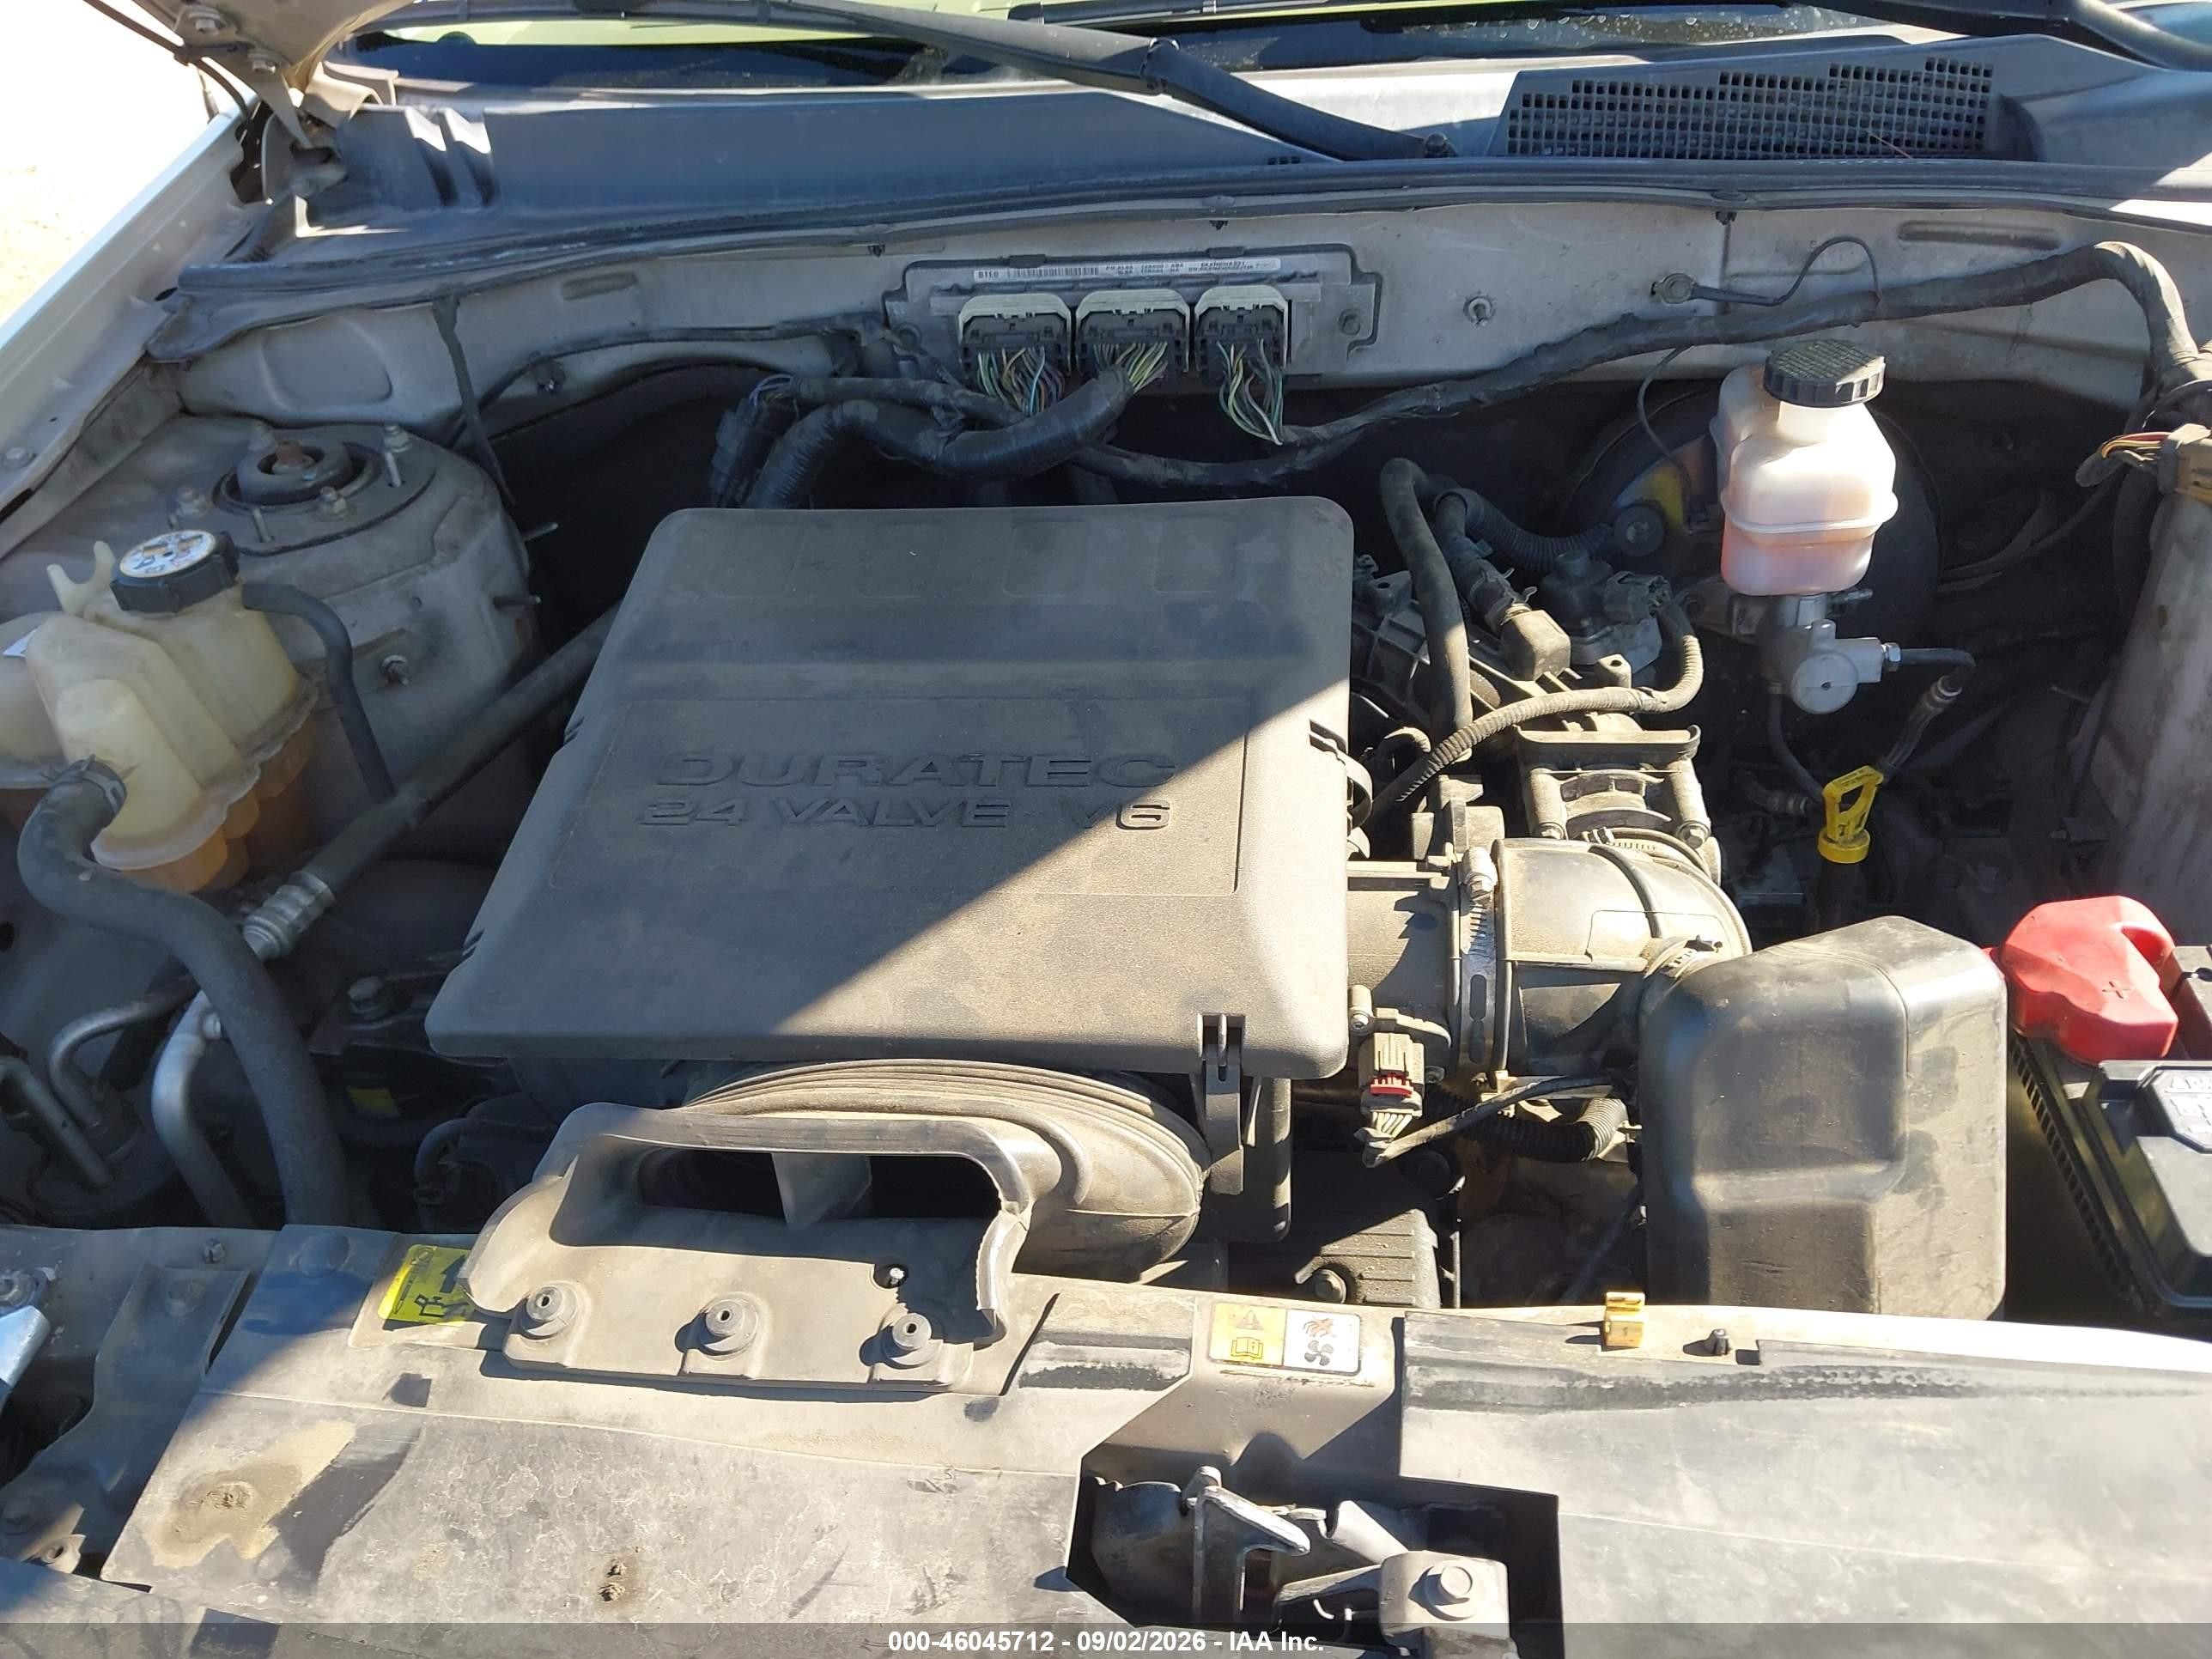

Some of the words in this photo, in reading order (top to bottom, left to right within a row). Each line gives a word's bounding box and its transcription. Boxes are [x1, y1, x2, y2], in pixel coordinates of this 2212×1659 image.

[656, 752, 1176, 787] DURATEC
[640, 796, 749, 826] 24
[773, 797, 1012, 828] VALVE
[1070, 799, 1170, 830] V6
